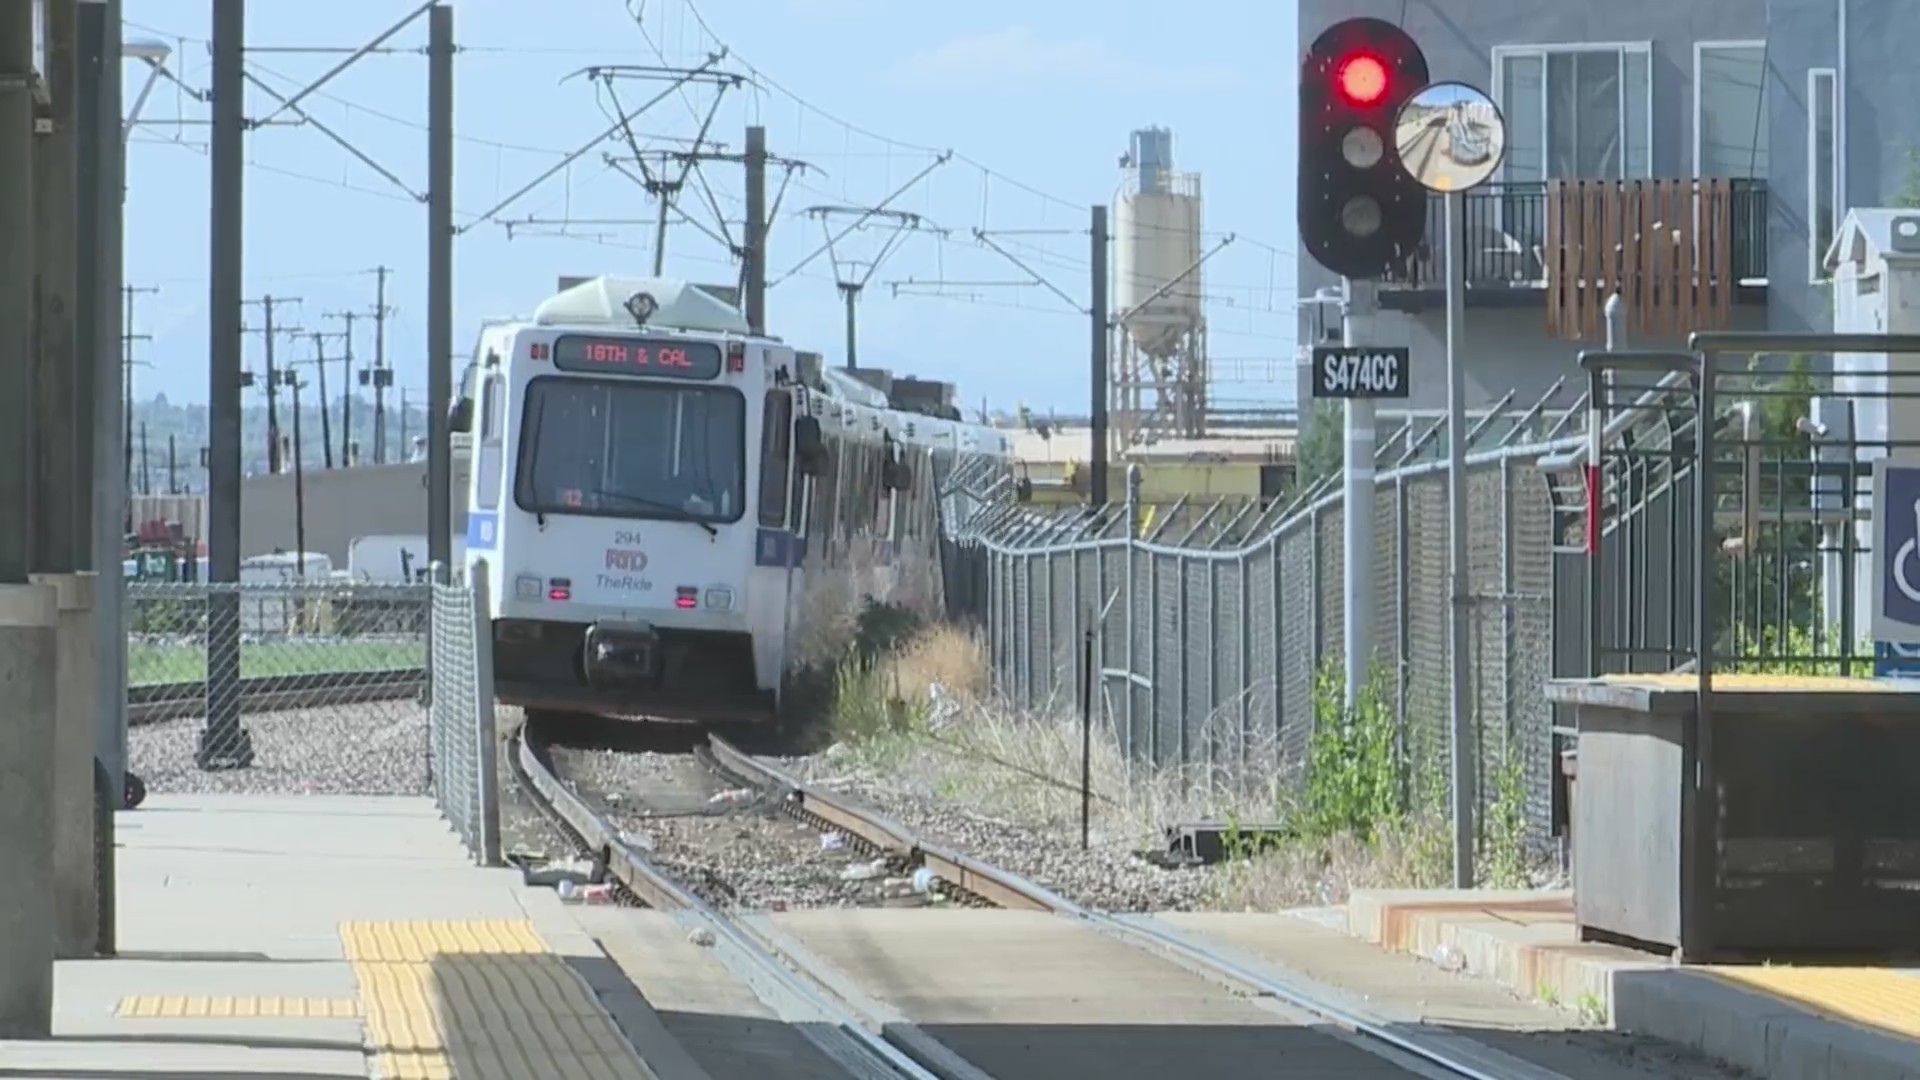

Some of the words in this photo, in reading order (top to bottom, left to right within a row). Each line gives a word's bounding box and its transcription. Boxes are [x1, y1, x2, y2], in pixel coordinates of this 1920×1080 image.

[637, 348, 648, 364] &
[658, 348, 692, 367] CAL
[1324, 354, 1398, 391] S474CC
[614, 530, 641, 545] 294
[605, 548, 648, 572] RTD
[596, 574, 653, 591] TheRide
